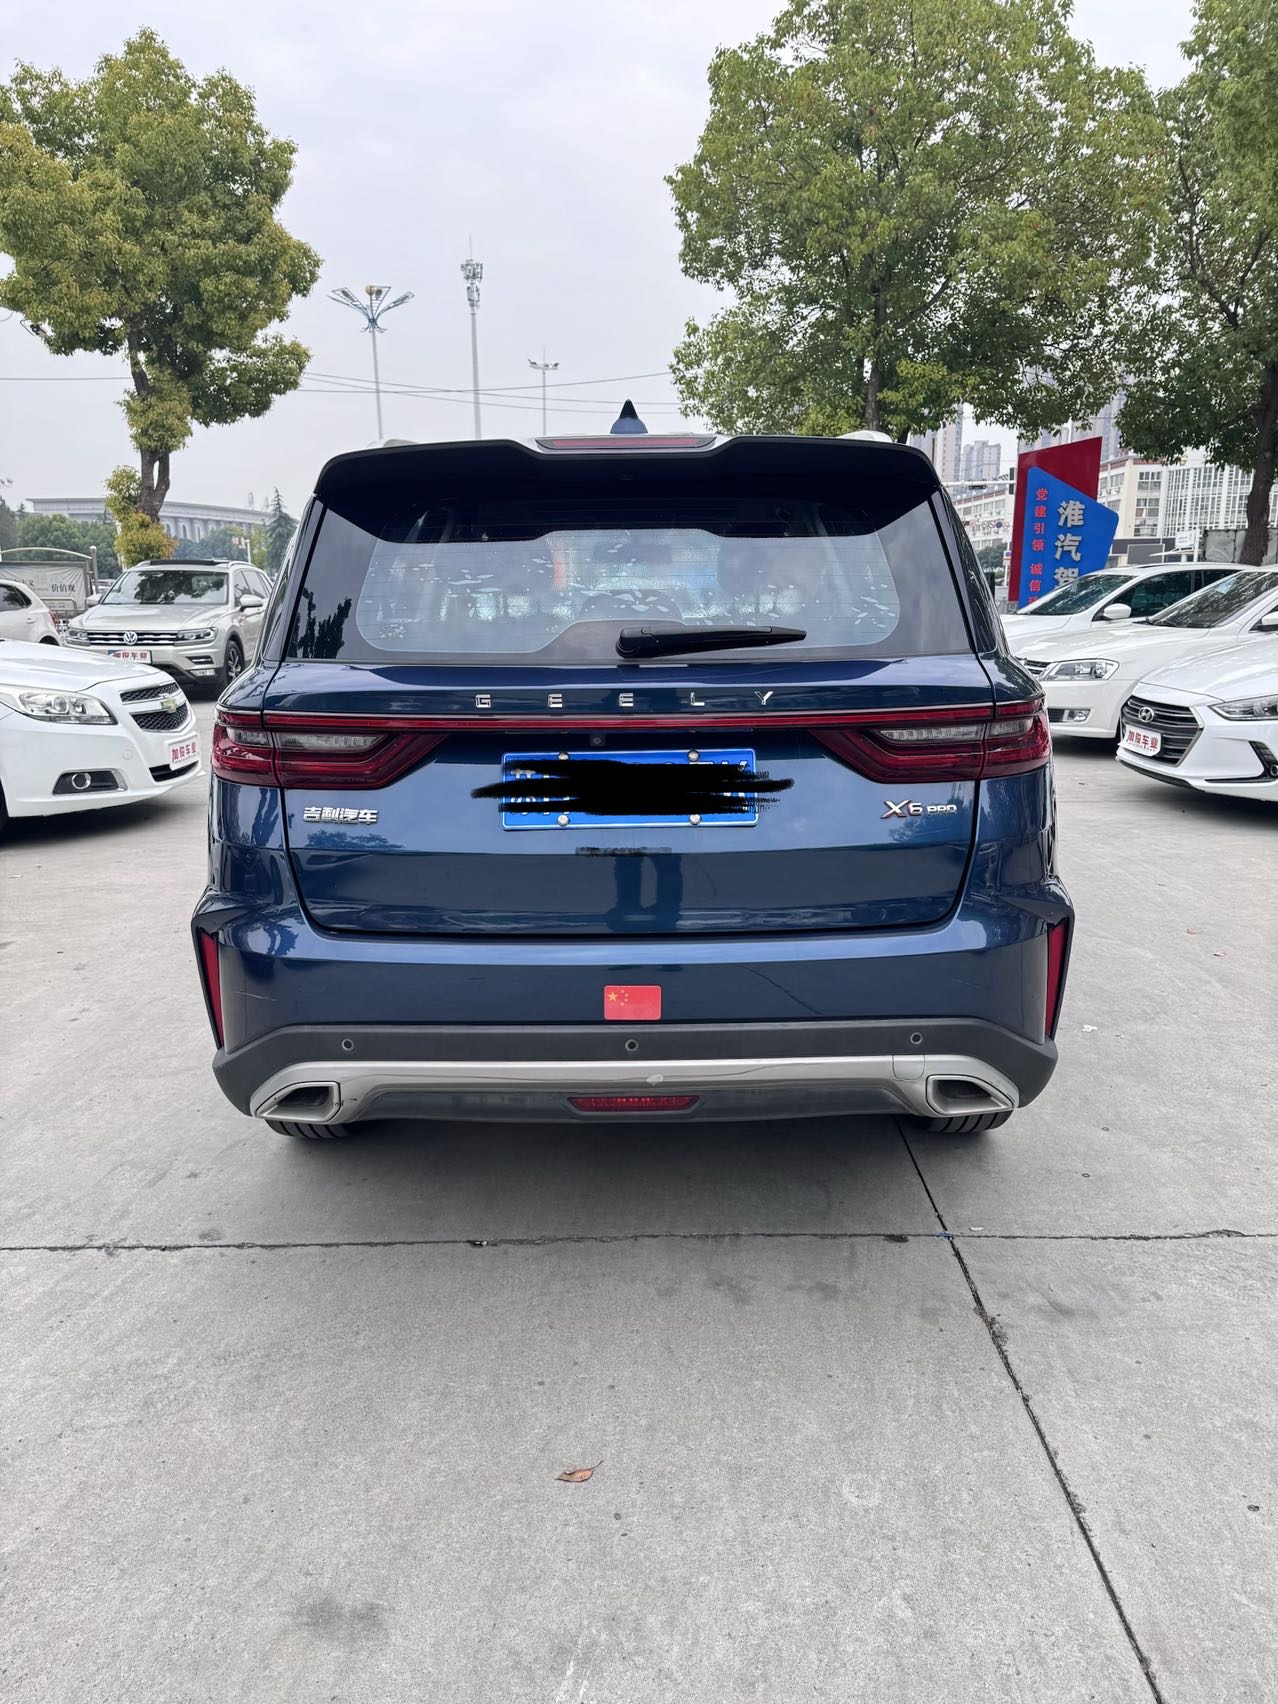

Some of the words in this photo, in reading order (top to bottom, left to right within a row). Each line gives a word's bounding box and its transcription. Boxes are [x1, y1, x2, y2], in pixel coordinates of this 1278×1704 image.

[1032, 488, 1048, 551] 党建引领
[475, 690, 774, 709] GEELY
[303, 806, 378, 824] 吉利汽车
[880, 799, 923, 819] X6
[926, 804, 958, 814] PRO
